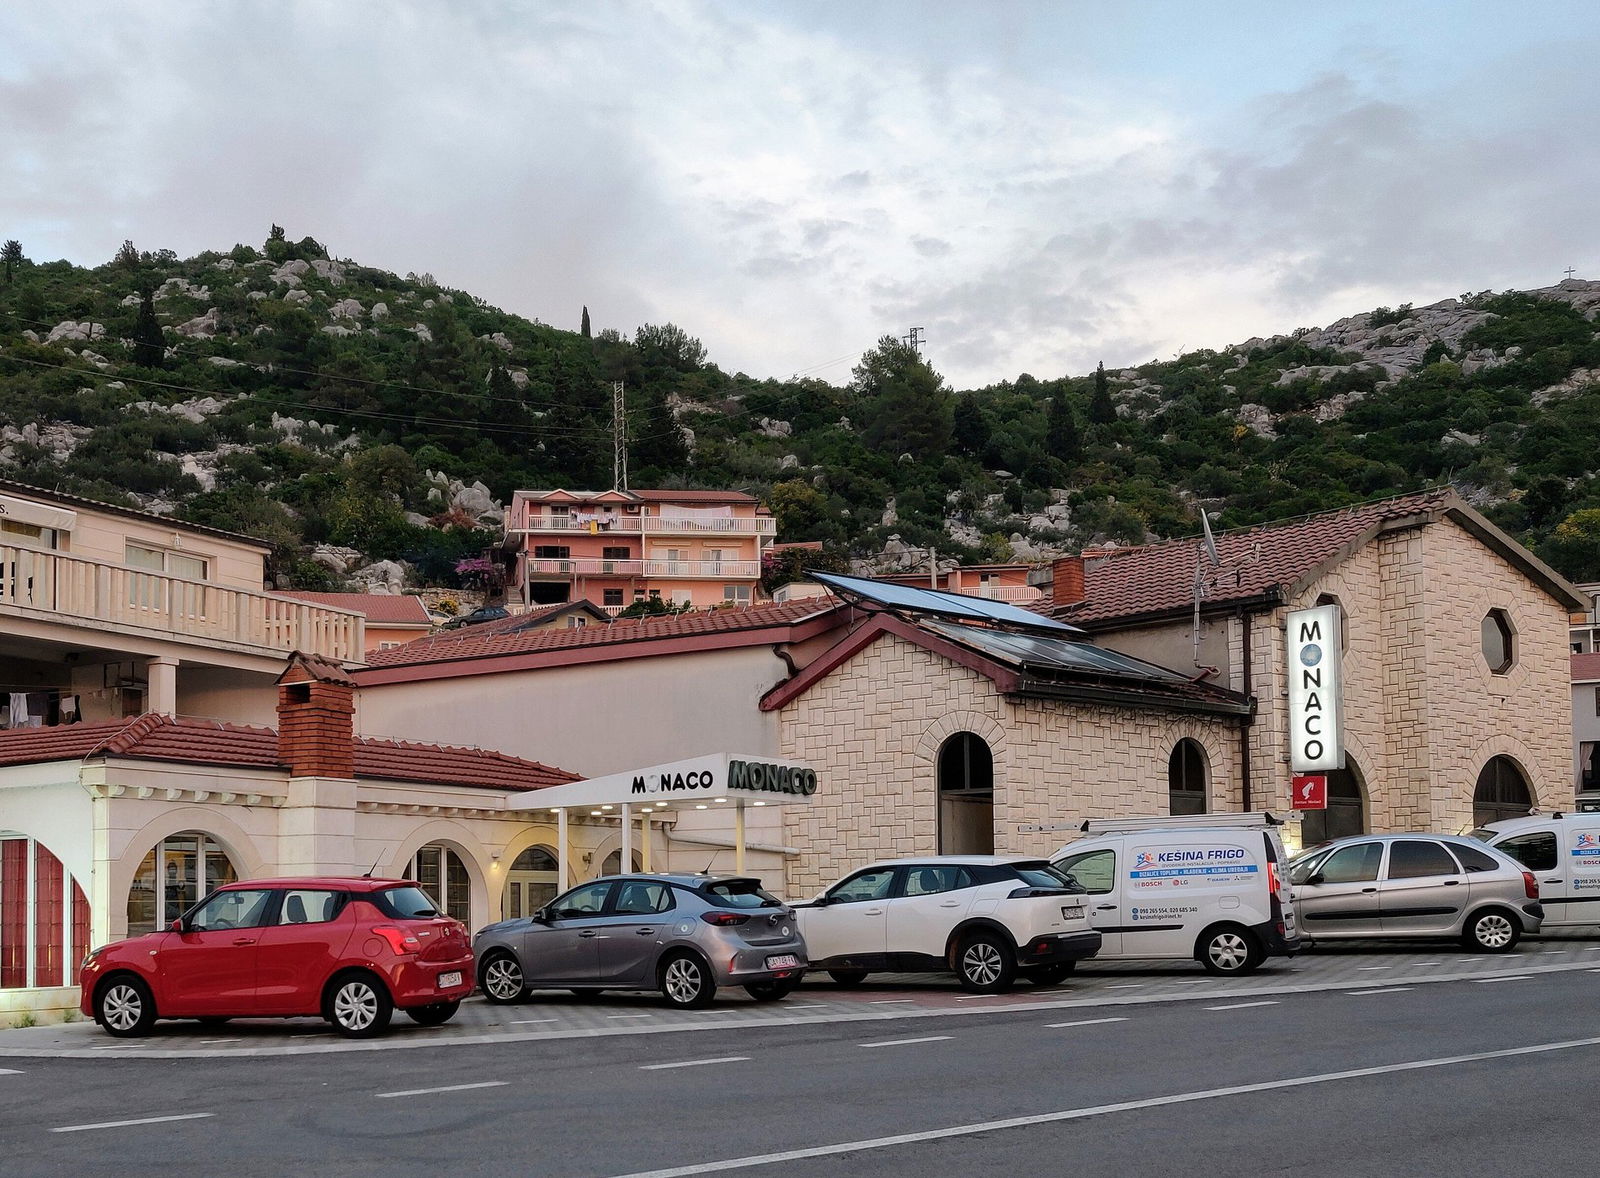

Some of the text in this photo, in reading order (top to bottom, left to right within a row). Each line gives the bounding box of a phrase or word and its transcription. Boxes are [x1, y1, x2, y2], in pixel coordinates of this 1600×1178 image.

[631, 770, 714, 794] MONACO
[727, 760, 817, 795] MONACO
[1158, 849, 1245, 862] KEŠINA FRIGO
